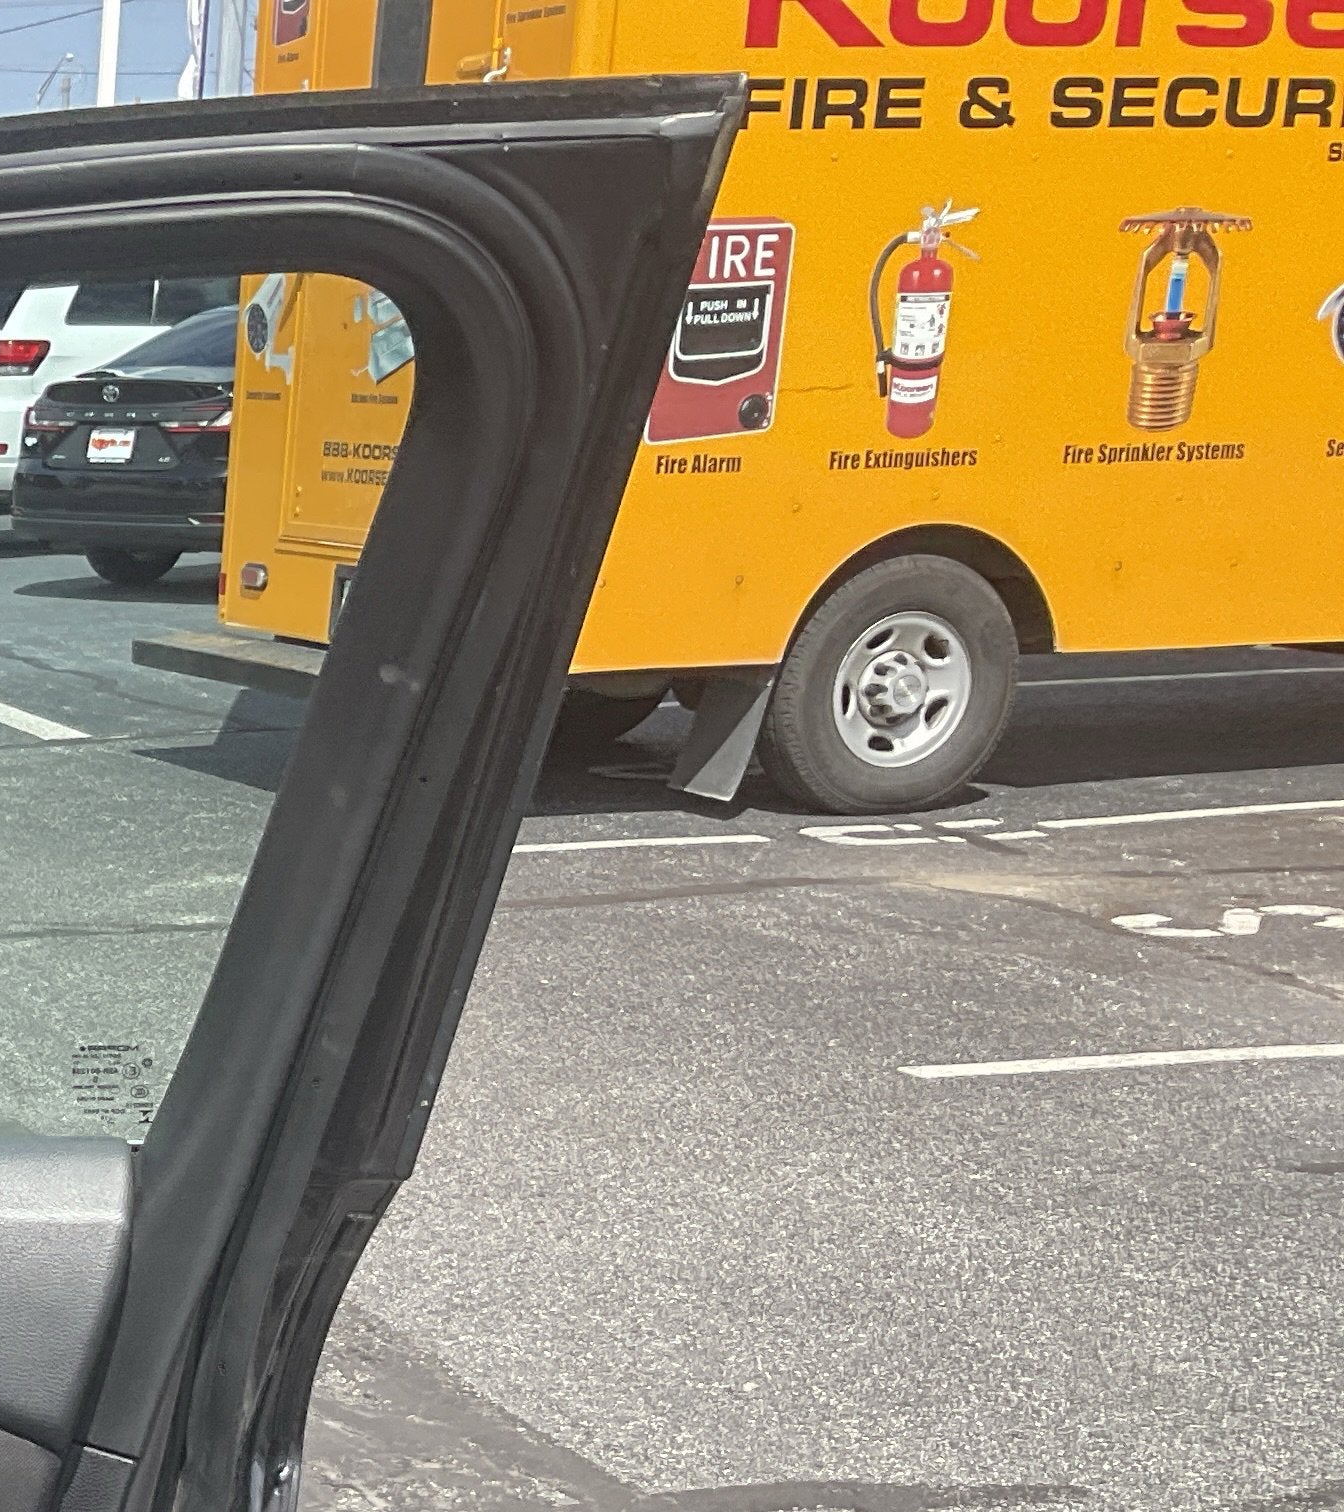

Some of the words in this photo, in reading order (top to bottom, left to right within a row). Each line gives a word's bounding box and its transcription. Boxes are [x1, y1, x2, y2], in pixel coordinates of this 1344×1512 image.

[740, 77, 926, 130] FIRE
[959, 77, 1016, 129] &
[1050, 77, 1344, 128] SECUR
[708, 233, 780, 279] IRE
[700, 300, 728, 311] PUSH
[694, 314, 719, 325] PULL
[721, 312, 752, 323] DOWN
[656, 455, 687, 474] Fire
[691, 454, 741, 474] Alarm
[829, 451, 860, 470] Fire
[864, 448, 978, 470] Extinguishers
[1063, 444, 1093, 464] Fire
[1097, 443, 1173, 465] Sprinkler
[1176, 441, 1245, 462] Systems
